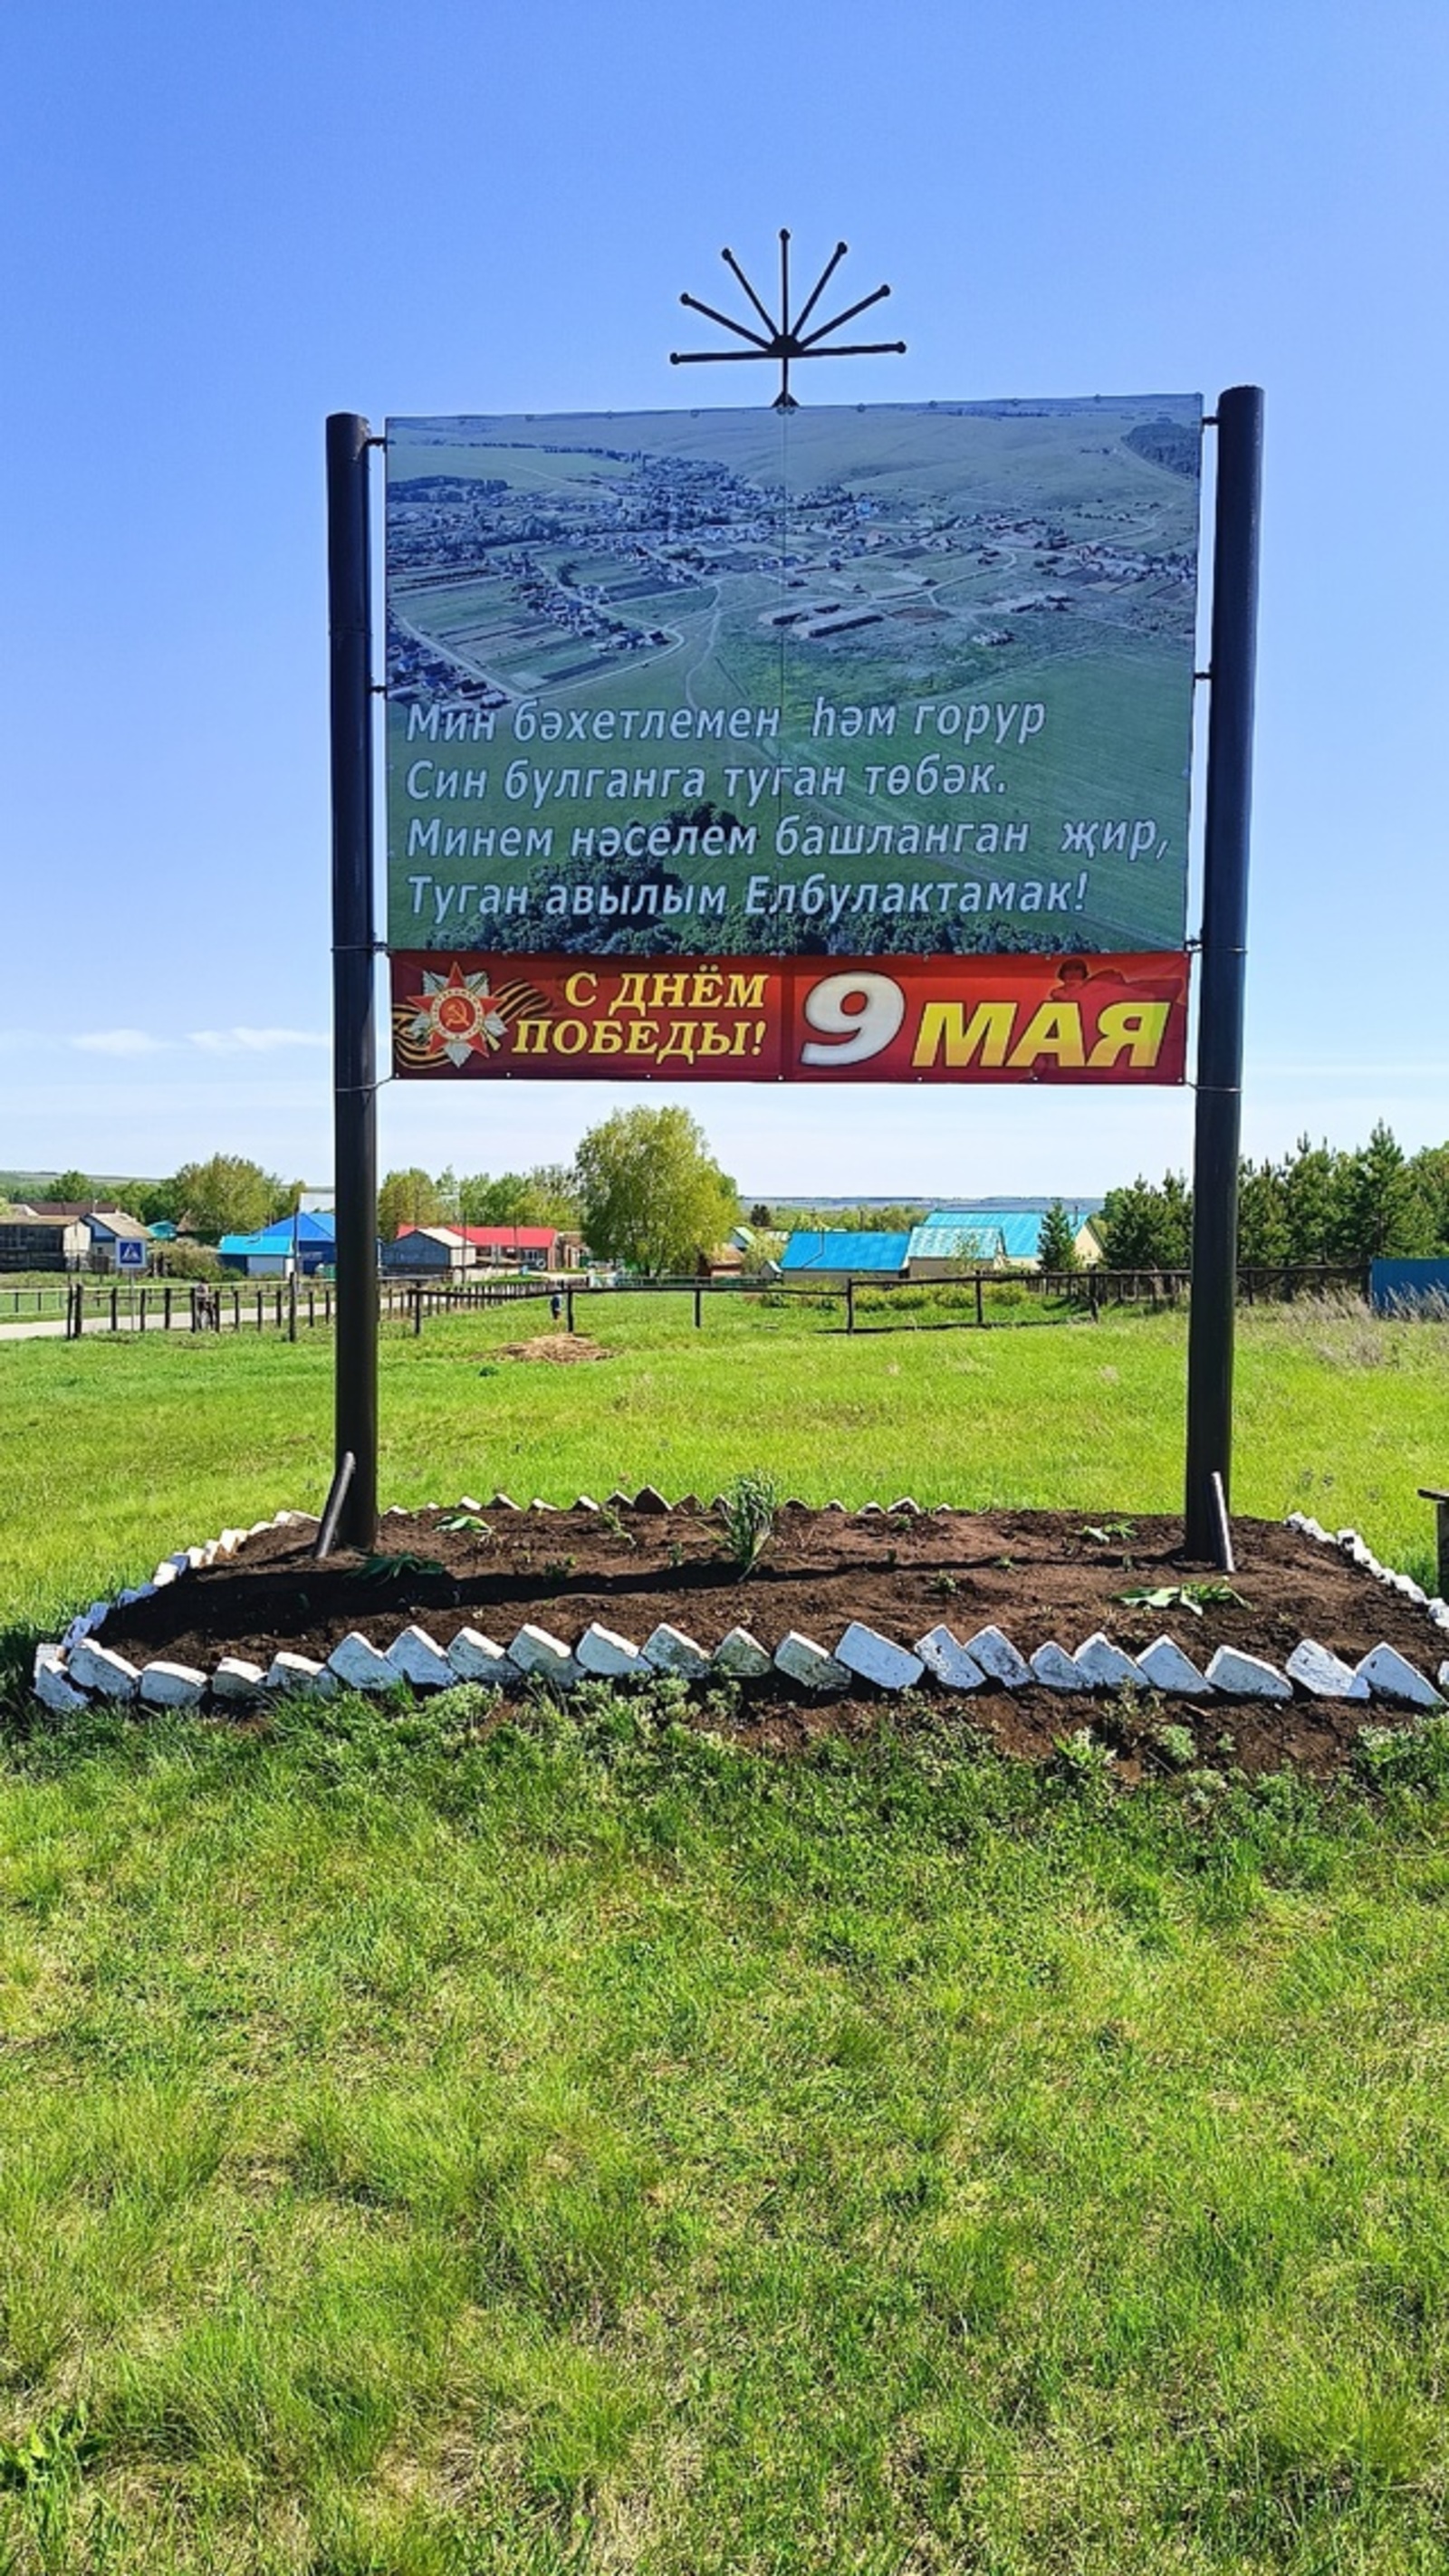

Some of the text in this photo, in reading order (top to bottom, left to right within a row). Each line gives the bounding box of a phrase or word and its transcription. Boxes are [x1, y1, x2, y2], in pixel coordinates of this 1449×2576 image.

[407, 697, 1046, 745] Мин бәхетлемен һәм горур
[407, 753, 1007, 809] Син булганга туган төбәк.
[407, 815, 1169, 861] Минем нәселем башланган җир,
[408, 871, 1089, 924] Туган авылым Елбулактамак!
[564, 963, 771, 1018] С ДНЁМ
[511, 1019, 768, 1066] ПОБЕДЫ!
[800, 970, 1172, 1068] 9 МАЯ
